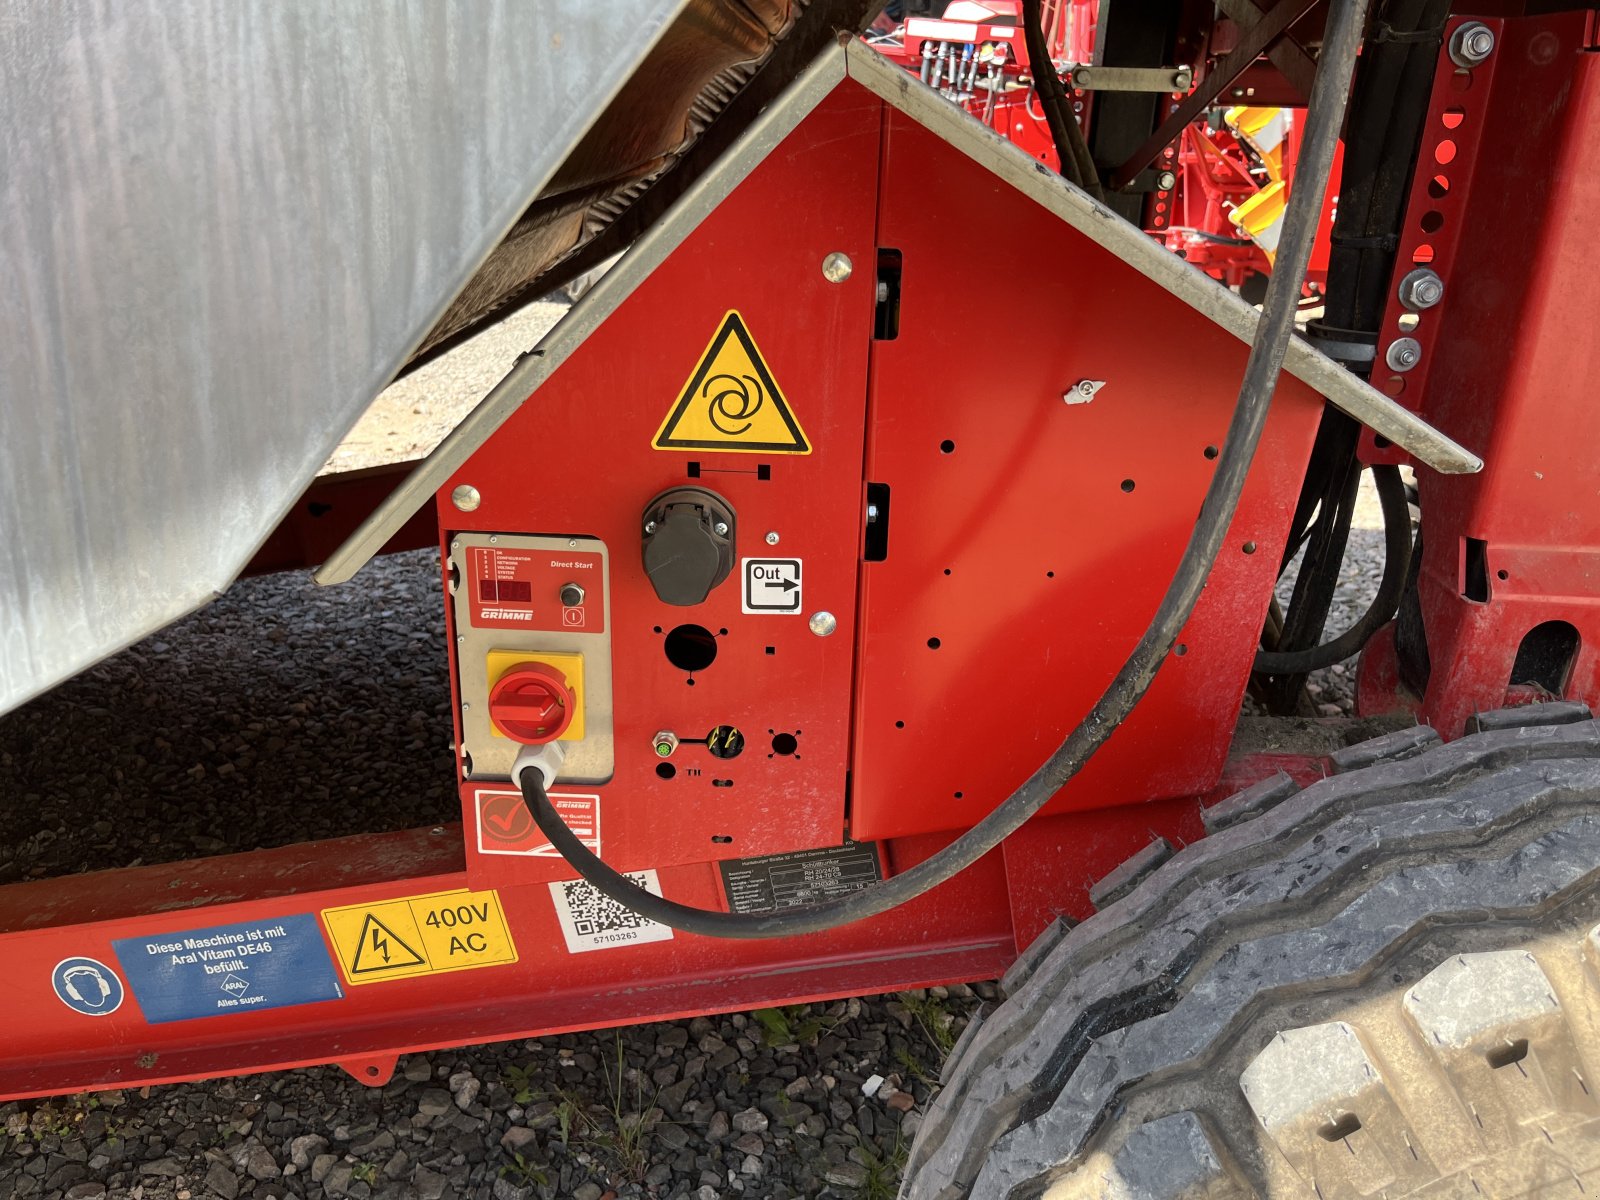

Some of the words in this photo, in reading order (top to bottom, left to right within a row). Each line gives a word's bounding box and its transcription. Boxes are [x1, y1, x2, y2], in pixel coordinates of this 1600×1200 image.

[753, 566, 780, 580] Out
[426, 902, 488, 929] 400V
[146, 942, 182, 954] Diese
[184, 934, 244, 950] Maschine
[246, 930, 264, 940] ist
[265, 926, 286, 938] mit
[449, 932, 487, 956] AC
[594, 932, 638, 944] 57103263
[172, 954, 197, 966] Aral
[200, 949, 236, 962] Vitam
[239, 942, 272, 956] DE46
[204, 960, 248, 974] befüllt.
[225, 981, 246, 990] ARAL
[218, 999, 238, 1008] Alles
[240, 996, 268, 1006] super.
